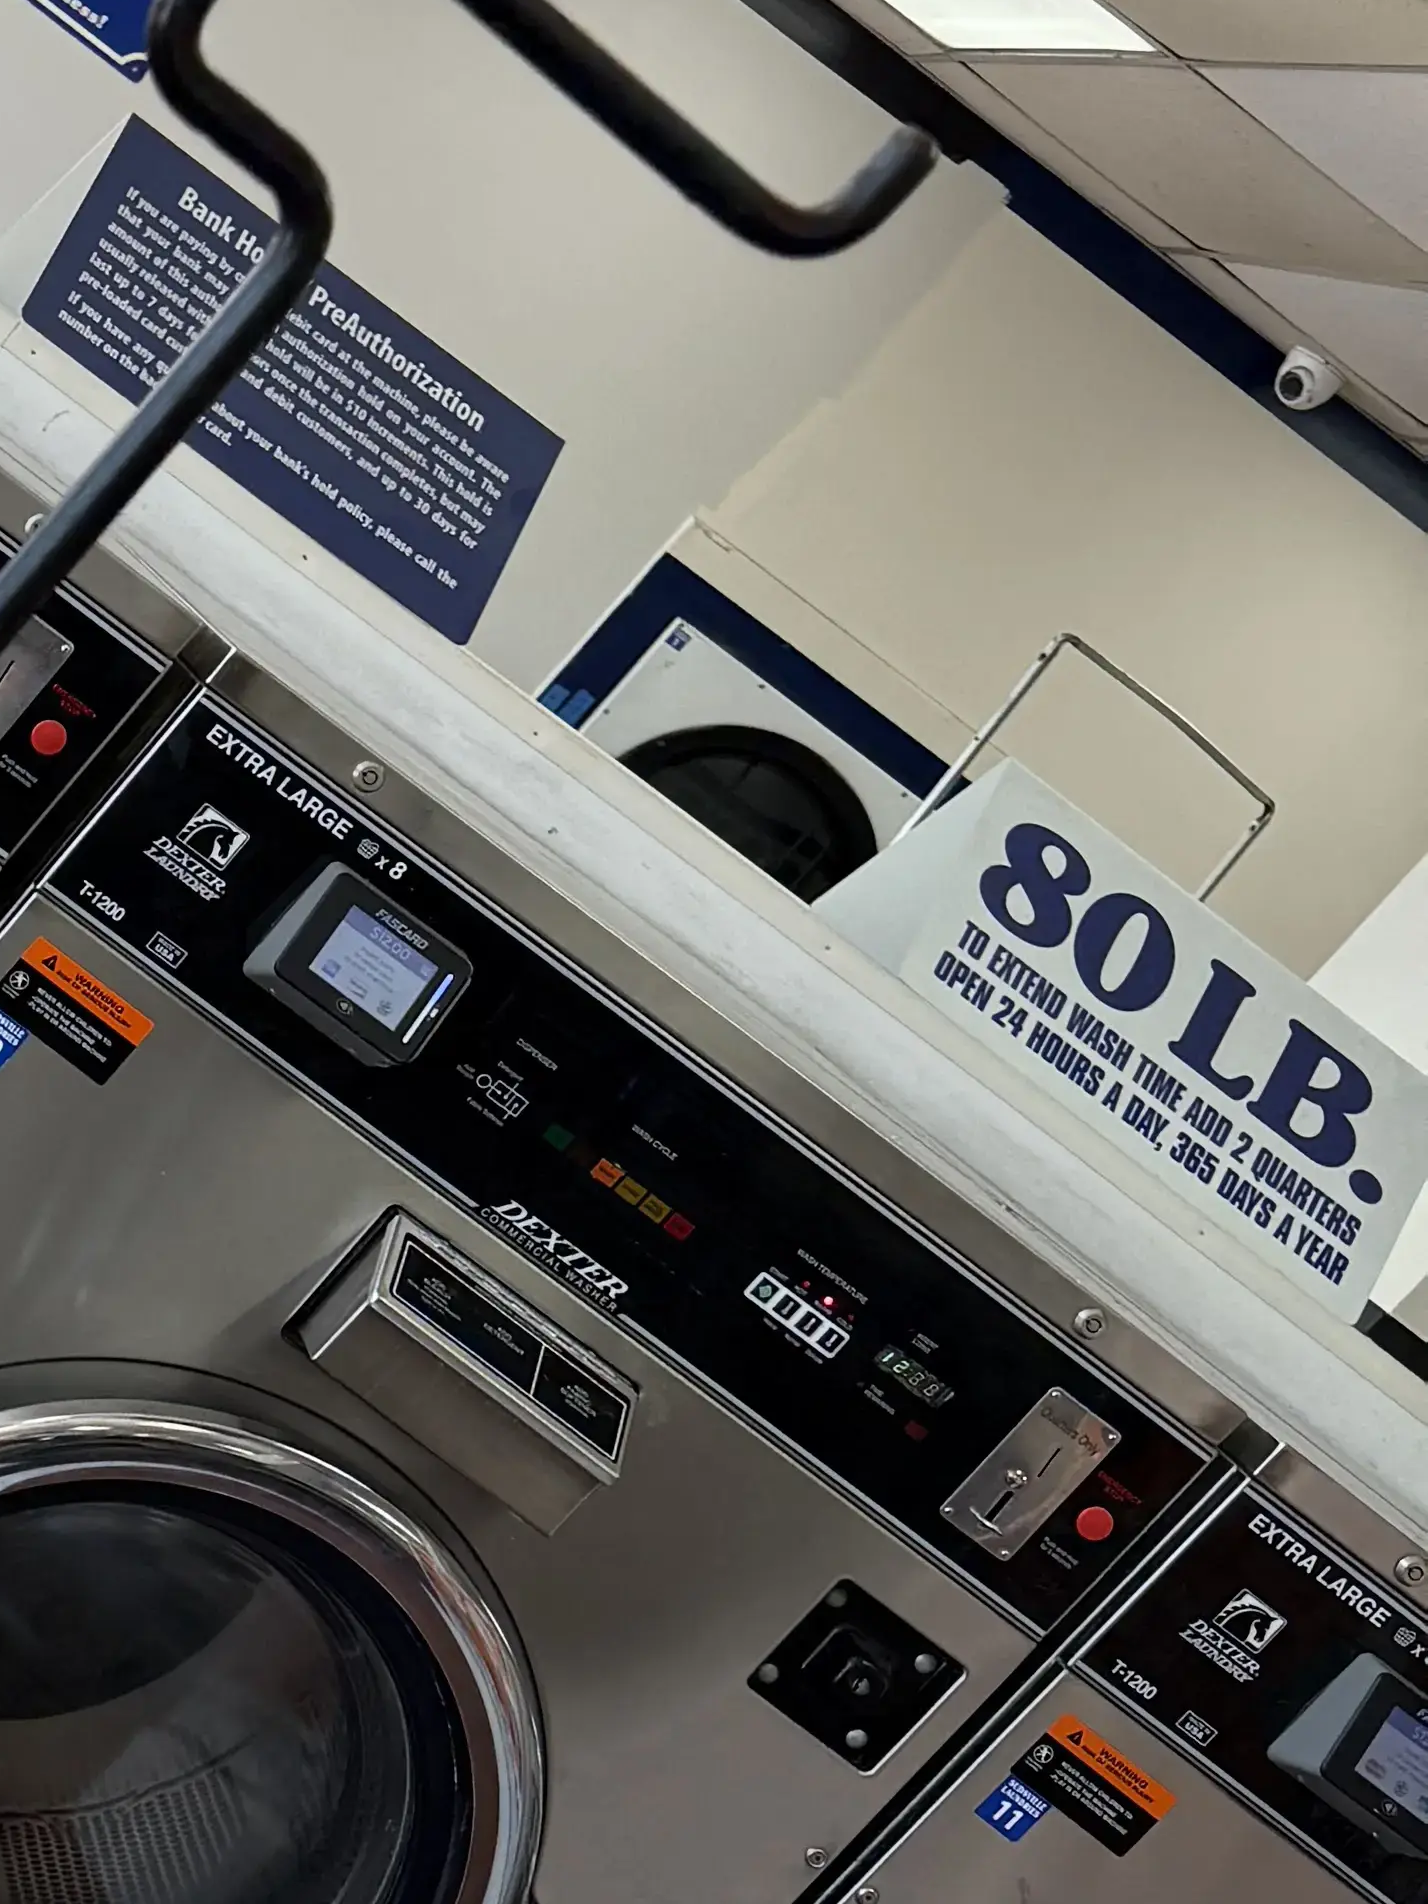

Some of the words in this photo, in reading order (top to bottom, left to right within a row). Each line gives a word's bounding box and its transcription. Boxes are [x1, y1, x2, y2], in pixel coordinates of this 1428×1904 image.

[125, 186, 140, 200] If
[135, 197, 159, 217] you
[159, 214, 179, 233] are
[178, 229, 218, 264] paying
[218, 256, 234, 275] by
[311, 330, 338, 353] card
[337, 349, 351, 363] at
[351, 358, 372, 379] the
[371, 375, 420, 418] machine,
[420, 413, 458, 445] please
[458, 438, 474, 457] be
[474, 453, 509, 483] aware
[174, 184, 241, 243] Bank
[304, 282, 489, 433] PreAuthorization
[244, 427, 273, 450] your
[273, 445, 309, 479] bank's
[310, 473, 339, 500] hold
[336, 496, 373, 529] policy,
[374, 525, 413, 556] please
[414, 553, 437, 573] call
[436, 568, 457, 589] the
[204, 722, 281, 786] EXTRA
[275, 775, 354, 841] LARGE
[387, 859, 409, 882] 8
[75, 880, 127, 923] T-1200
[142, 844, 220, 904] LAUNDRY
[152, 833, 227, 892] DEXTER
[374, 906, 429, 952] FASCARD
[72, 971, 126, 1015] WARNING
[979, 822, 1175, 1011] 80
[1167, 958, 1382, 1204] LB.
[933, 950, 995, 1011] OPEN
[991, 995, 1028, 1037] 24
[1025, 1021, 1105, 1096] HOURS
[1101, 1081, 1123, 1112] A
[1121, 1094, 1169, 1151] DAY,
[1169, 1131, 1219, 1184] 365
[1216, 1167, 1276, 1228] DAYS
[1272, 1213, 1294, 1244] A
[1293, 1224, 1349, 1285] YEAR
[958, 920, 990, 960] TO
[986, 944, 1067, 1019] EXTEND
[1066, 1002, 1134, 1071] WASH
[1132, 1053, 1187, 1112] TIME
[1182, 1096, 1232, 1147] ADD
[1229, 1131, 1253, 1164] 2
[1250, 1147, 1361, 1245] QUARTERS
[479, 1206, 564, 1273] COMMERCIAL
[563, 1269, 619, 1313] WASHER
[490, 1191, 630, 1302] DEXTER
[1246, 1511, 1321, 1574] EXTRA
[1315, 1564, 1393, 1629] LARGE
[1108, 1657, 1159, 1701] T-1200
[1178, 1625, 1254, 1685] LAUNDRY
[1188, 1616, 1262, 1676] DEXTER
[1097, 1746, 1150, 1790] WARNING
[991, 1797, 1025, 1831] 11
